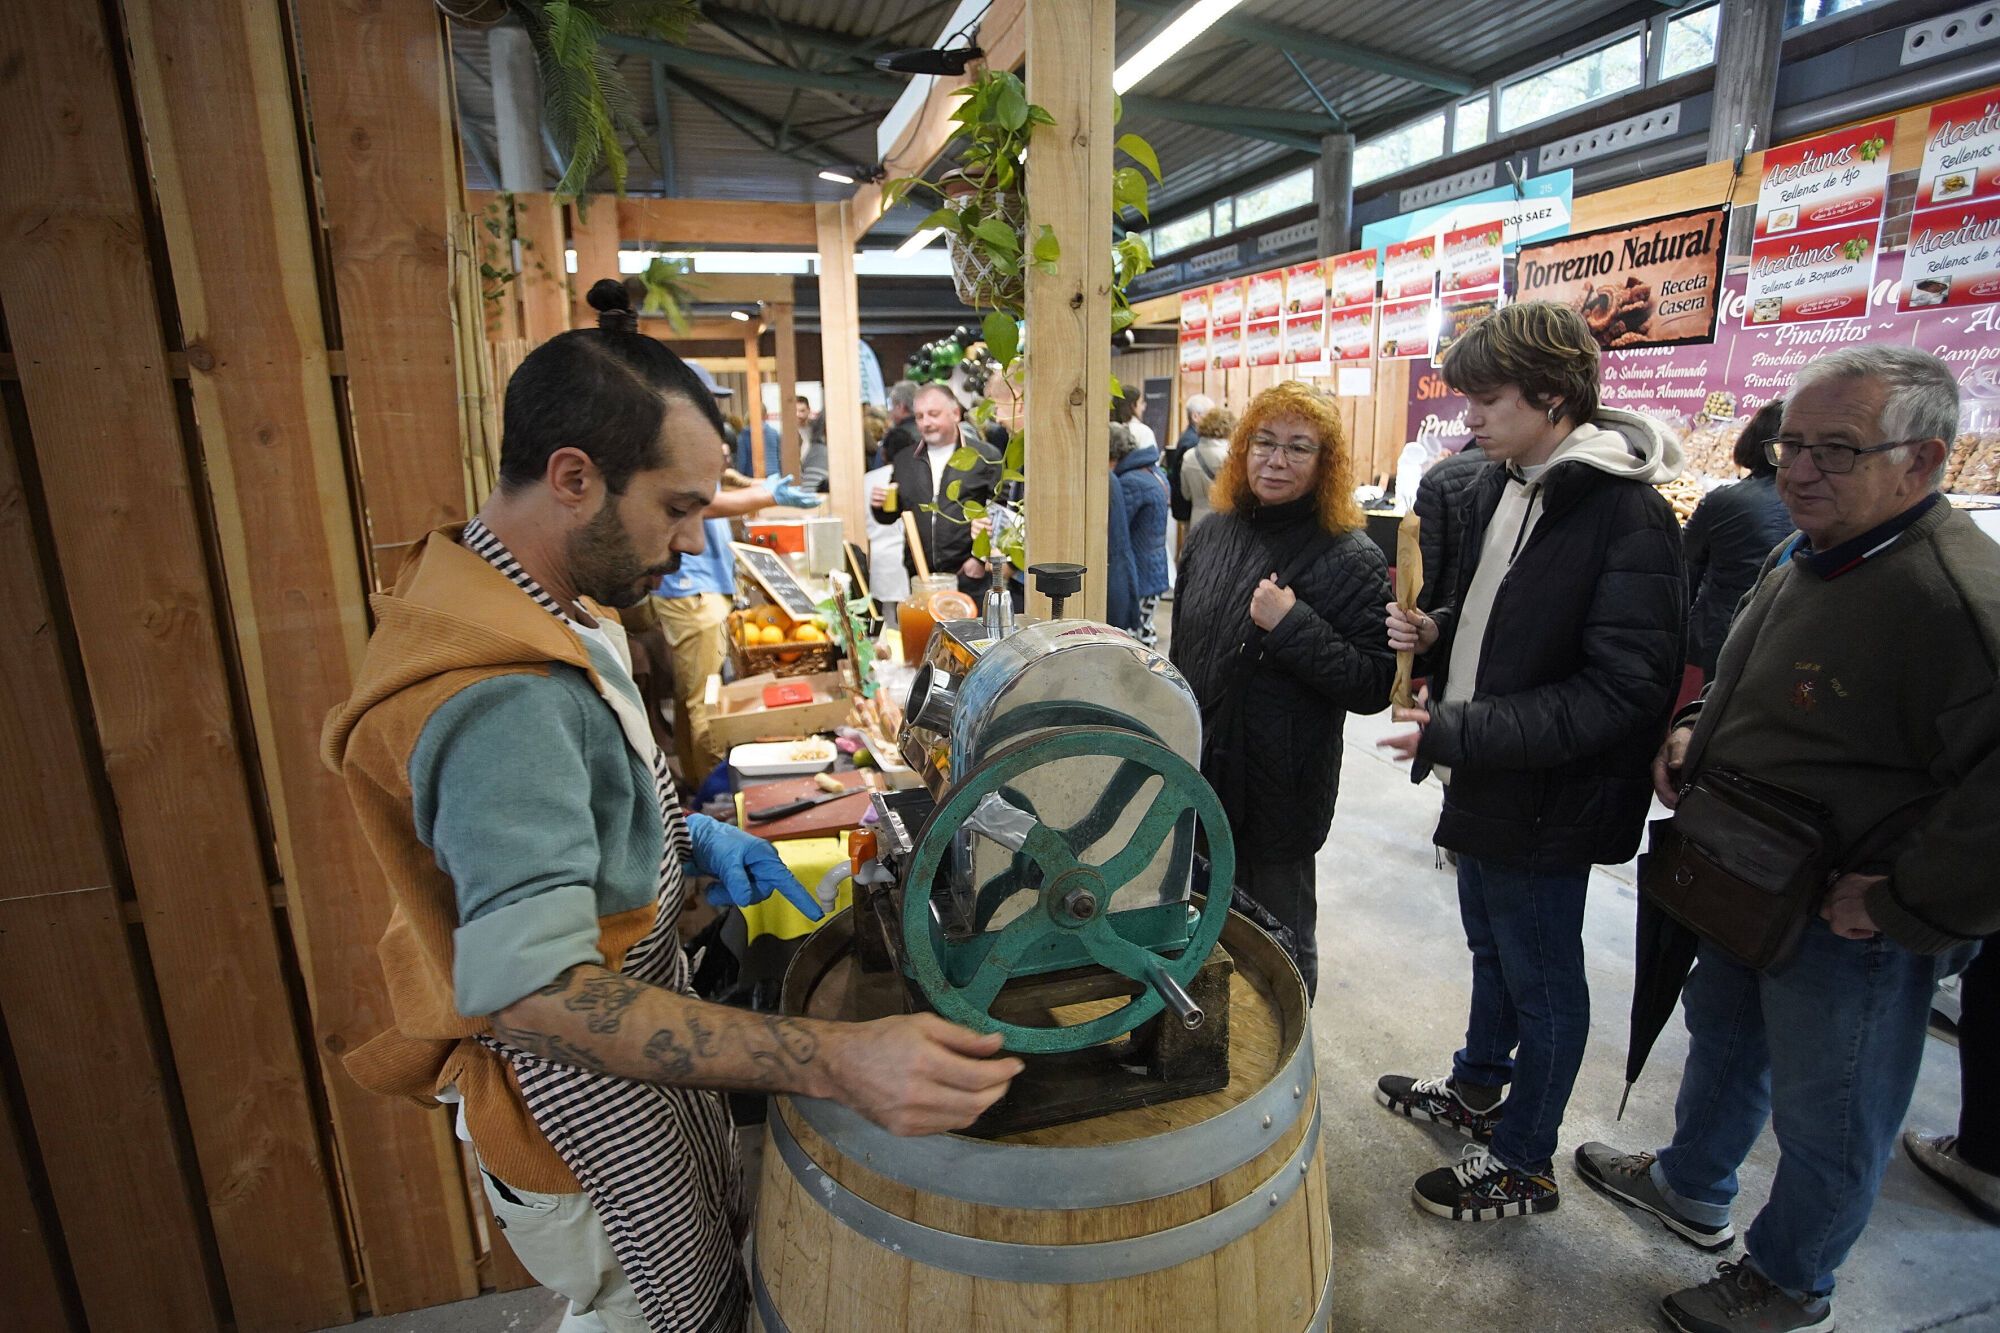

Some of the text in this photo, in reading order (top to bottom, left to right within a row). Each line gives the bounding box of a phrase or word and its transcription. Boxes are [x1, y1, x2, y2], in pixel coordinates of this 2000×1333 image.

[1763, 144, 1857, 190] Aceitunas
[1940, 144, 1994, 169] Rellenas
[1780, 166, 1860, 202] Rellenas de Ajo
[1526, 208, 1552, 223] SAEZ
[1910, 214, 2000, 257] Aceitun
[1524, 248, 1614, 290] Torrezno
[1619, 218, 1716, 272] Natural
[1752, 242, 1840, 280] Aceitunas
[1927, 255, 1971, 274] Rellenas
[1974, 246, 1989, 262] de
[1660, 273, 1708, 297] Receta
[1760, 264, 1853, 295] Rellenas de Boquerón
[1658, 293, 1706, 316] Casera
[1775, 319, 1872, 347] Pinchitos
[1619, 362, 1654, 381] Salmón
[1655, 359, 1708, 379] Ahumado
[1751, 347, 1807, 367] Pinchito
[1656, 380, 1706, 399] Ahumado
